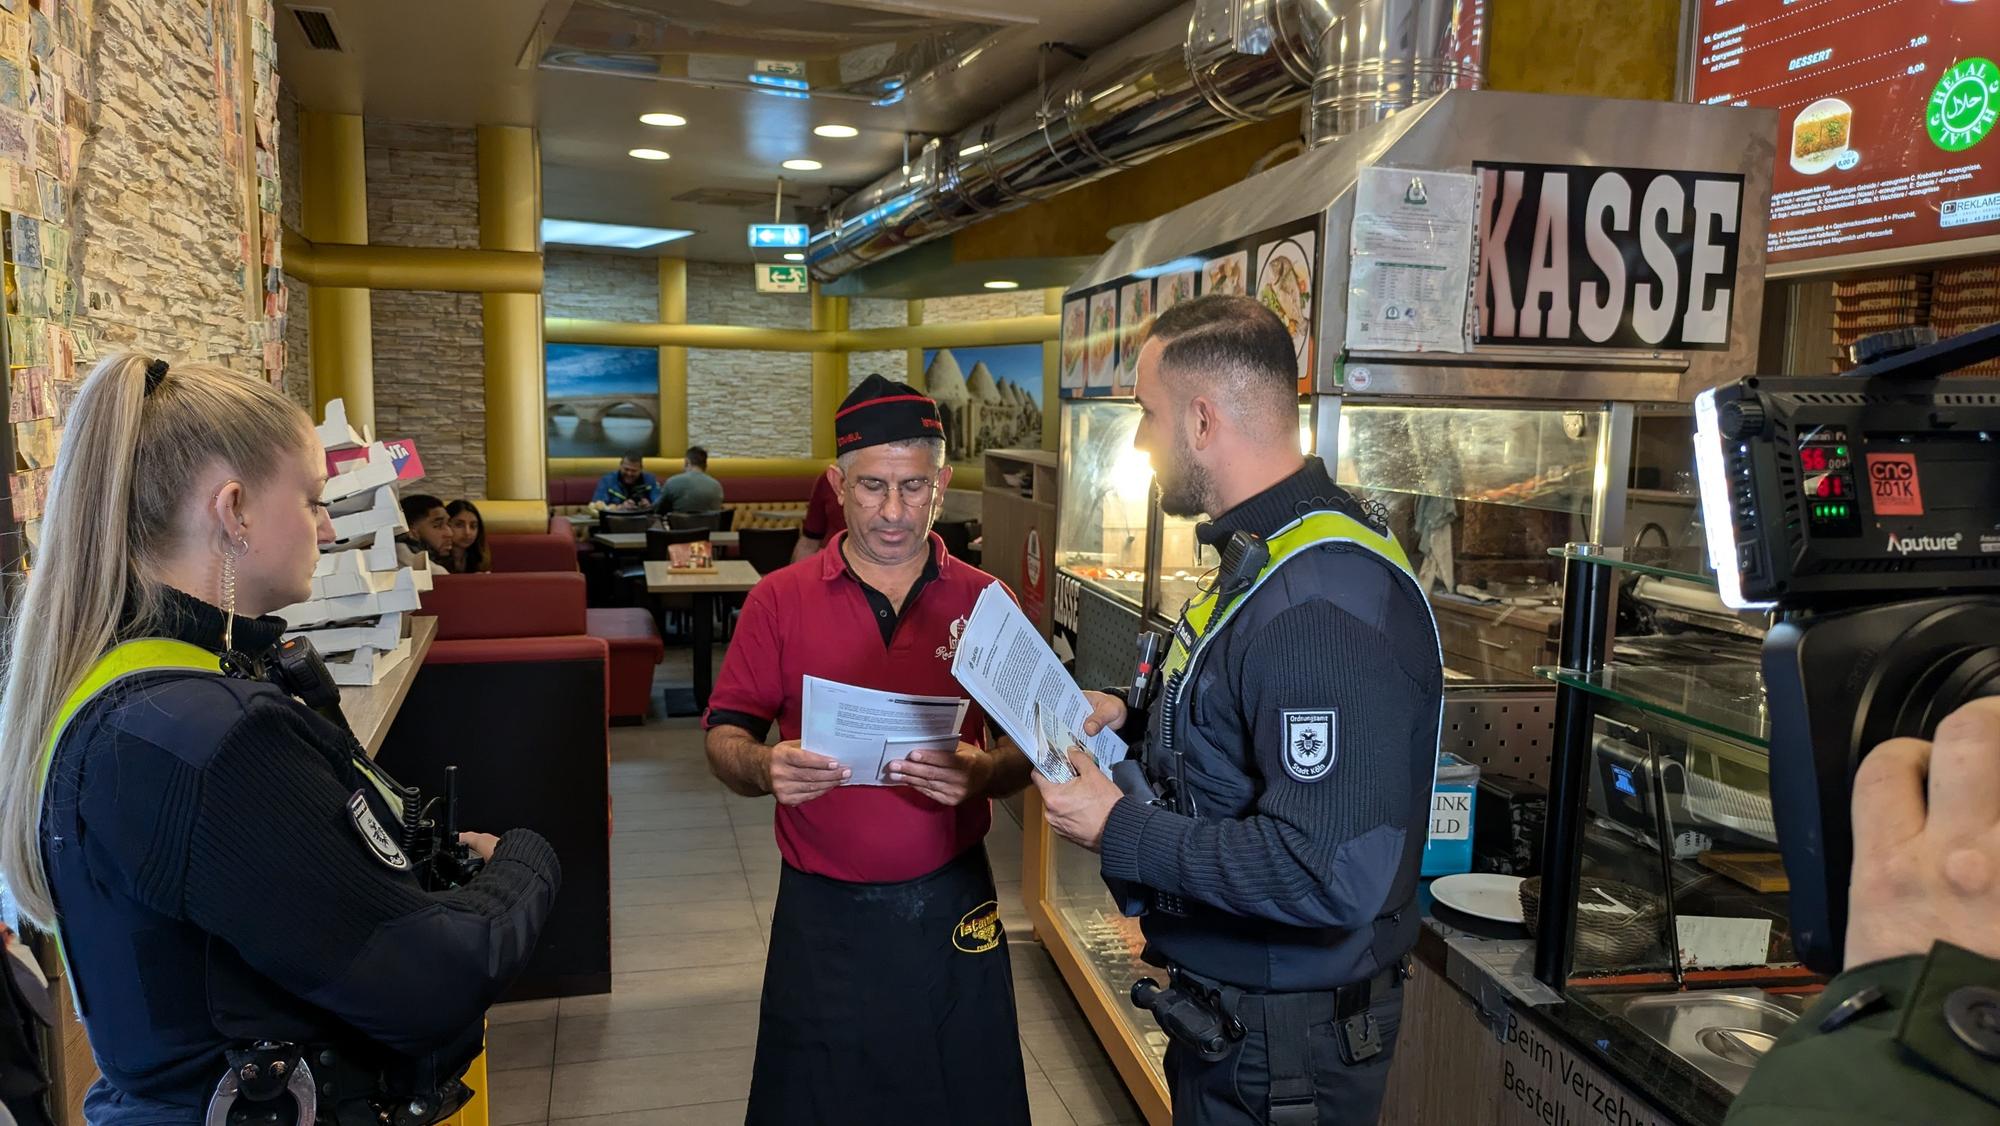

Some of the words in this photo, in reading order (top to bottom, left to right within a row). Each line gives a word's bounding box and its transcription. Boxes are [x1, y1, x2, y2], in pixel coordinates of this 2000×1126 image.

[1910, 35, 1928, 48] 7,00
[1788, 48, 1833, 71] DESSERT
[1934, 63, 1987, 105] HELAL
[1940, 107, 1997, 146] HALAL
[1482, 169, 1740, 344] KASSE
[1887, 533, 1958, 556] Aputure
[1290, 715, 1328, 723] Ordnungsamt
[1292, 763, 1310, 775] Stadt
[1310, 763, 1326, 774] Köln
[1432, 796, 1469, 811] INK
[1507, 1014, 1552, 1074] Beim
